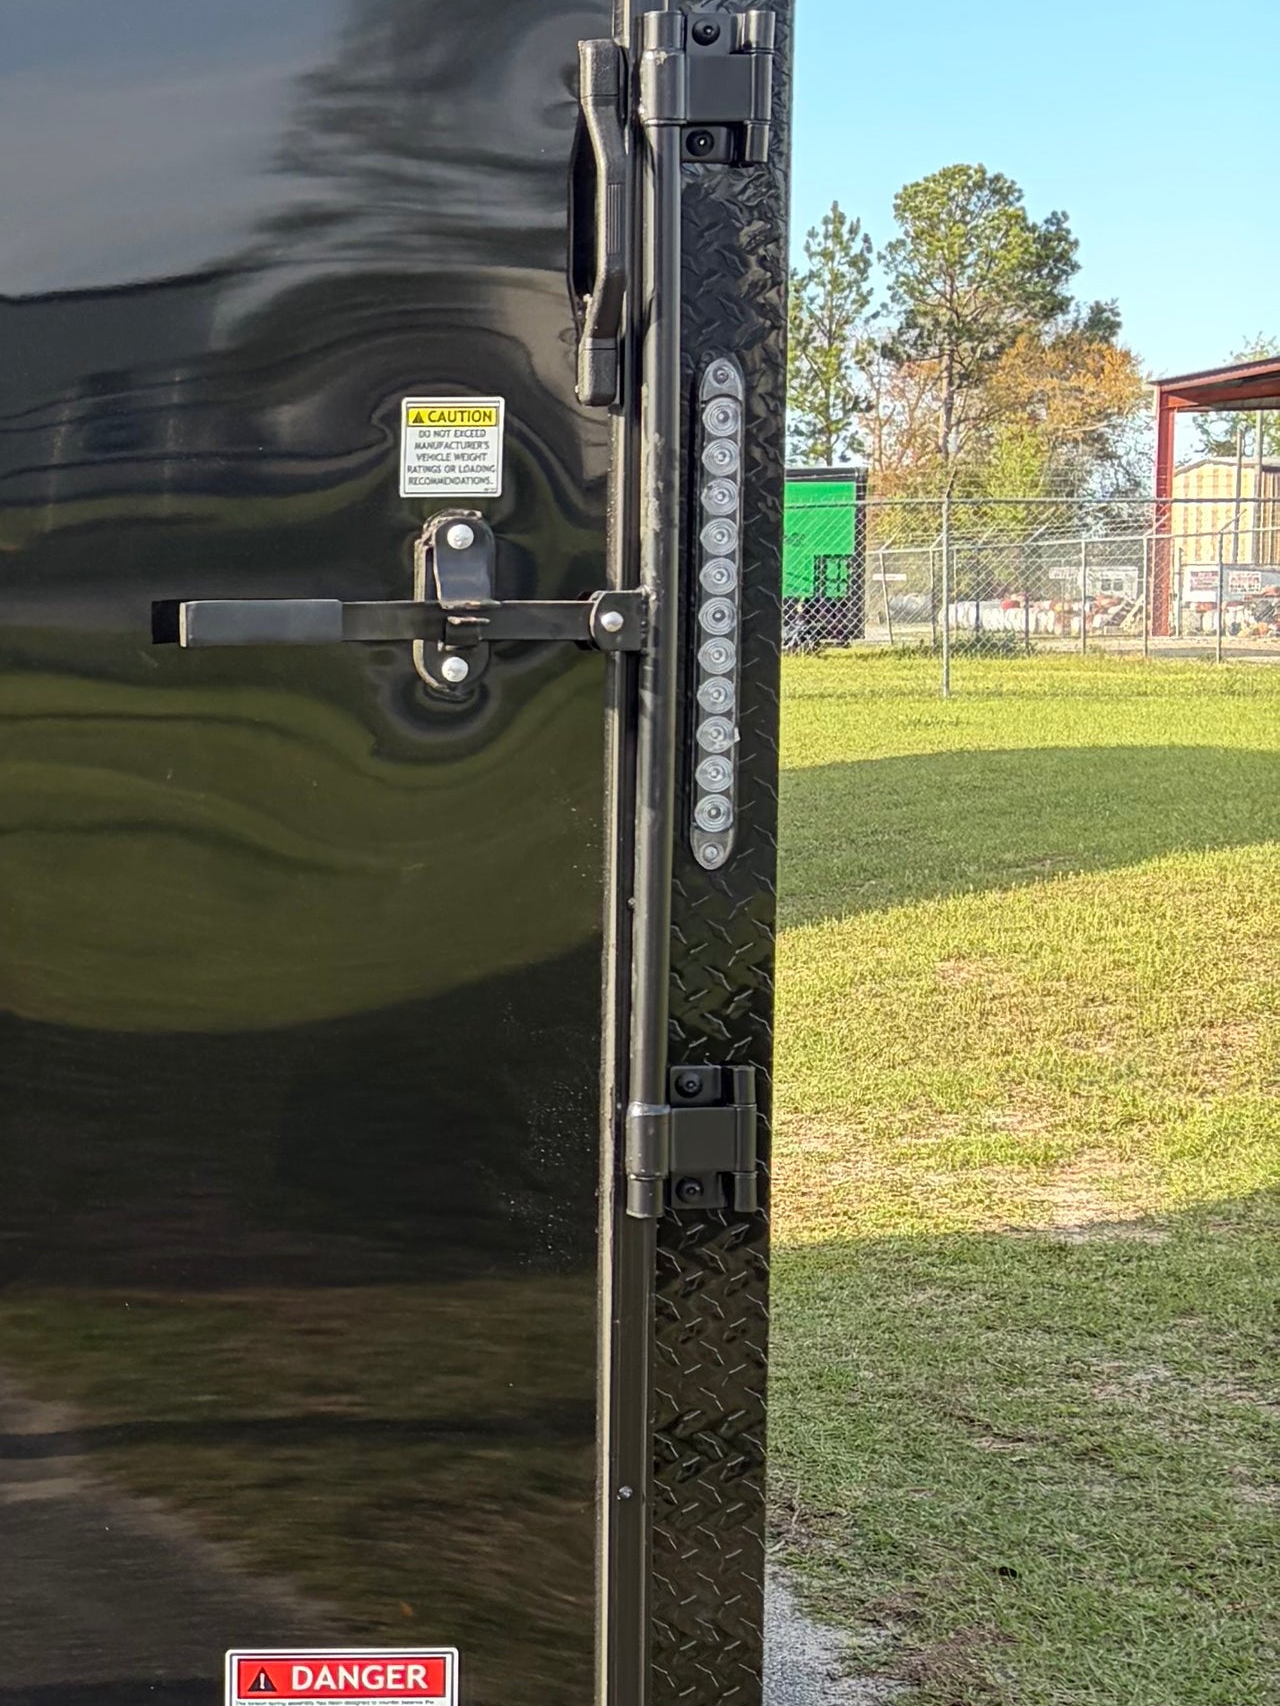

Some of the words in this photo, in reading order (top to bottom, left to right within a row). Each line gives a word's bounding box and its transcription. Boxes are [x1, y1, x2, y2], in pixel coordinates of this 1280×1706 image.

[427, 409, 493, 423] CAUTION
[419, 429, 431, 438] DO
[433, 429, 451, 438] NOT
[454, 429, 487, 438] EXCEED
[414, 441, 490, 450] MANUFACTURER'S
[416, 453, 451, 461] VEHICLE
[454, 452, 488, 461] WEIGHT
[407, 465, 442, 473] RATINGS
[444, 465, 456, 473] OR
[458, 465, 496, 473] LOADING
[408, 476, 495, 486] RECOMMENDATIONS.
[291, 1663, 429, 1691] DANGER
